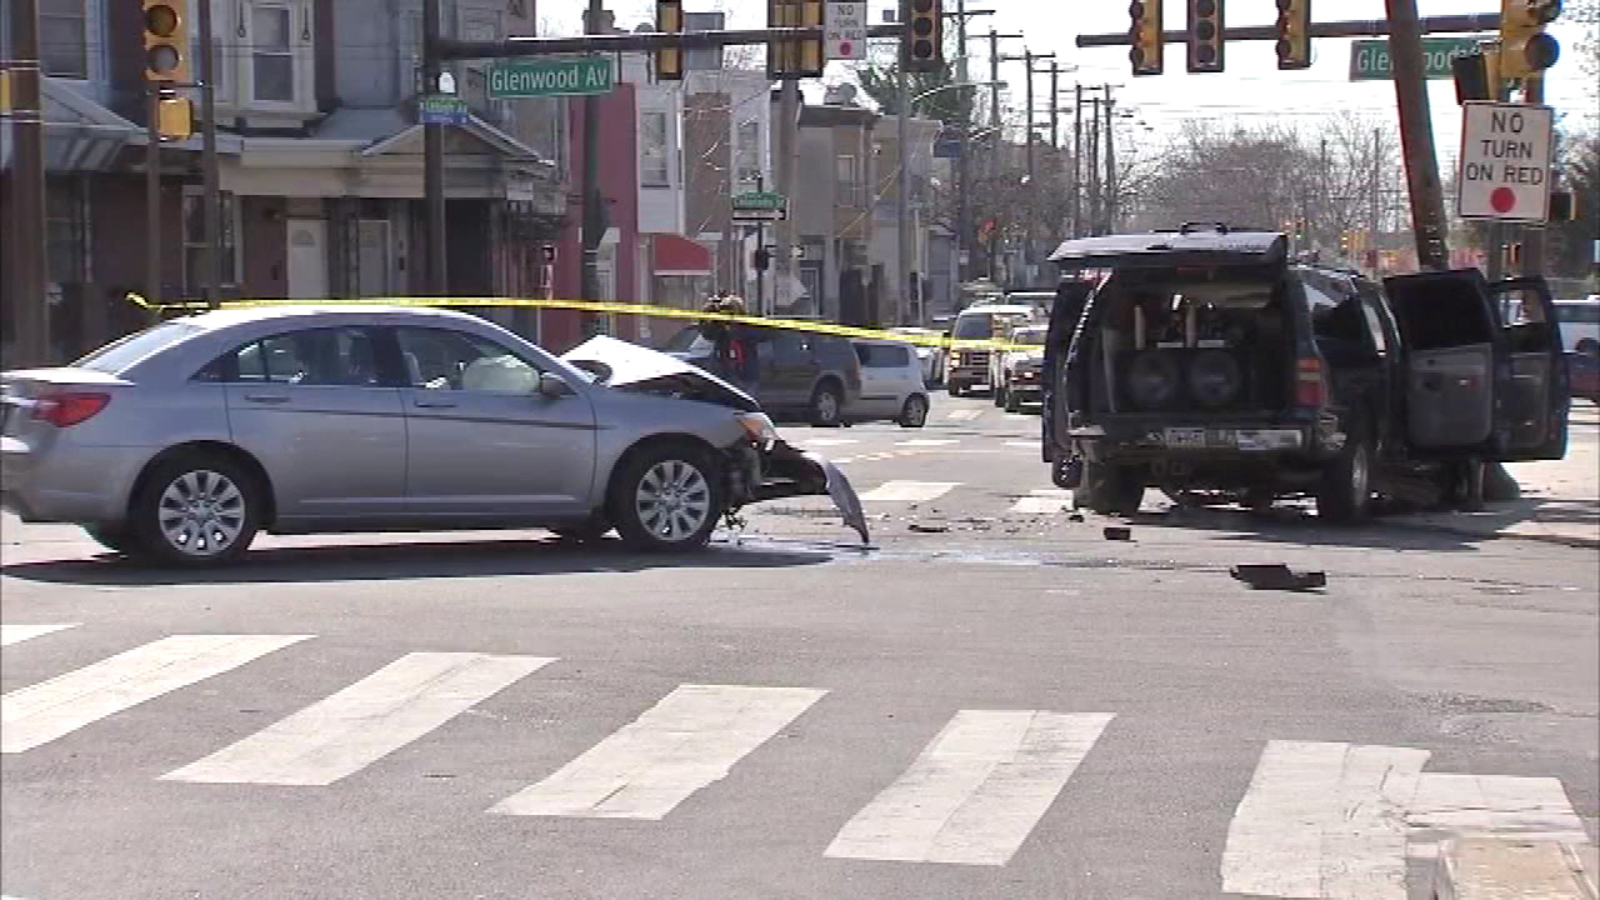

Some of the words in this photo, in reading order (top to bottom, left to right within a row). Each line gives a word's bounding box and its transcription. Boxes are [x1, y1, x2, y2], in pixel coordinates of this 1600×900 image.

[837, 4, 855, 16] NO
[1357, 44, 1460, 71] Gleood
[492, 64, 579, 91] Glenwood
[586, 64, 607, 86] Av
[1491, 112, 1525, 134] NO
[1480, 140, 1533, 159] TURN
[1466, 162, 1494, 181] ON
[1503, 164, 1544, 186] RED
